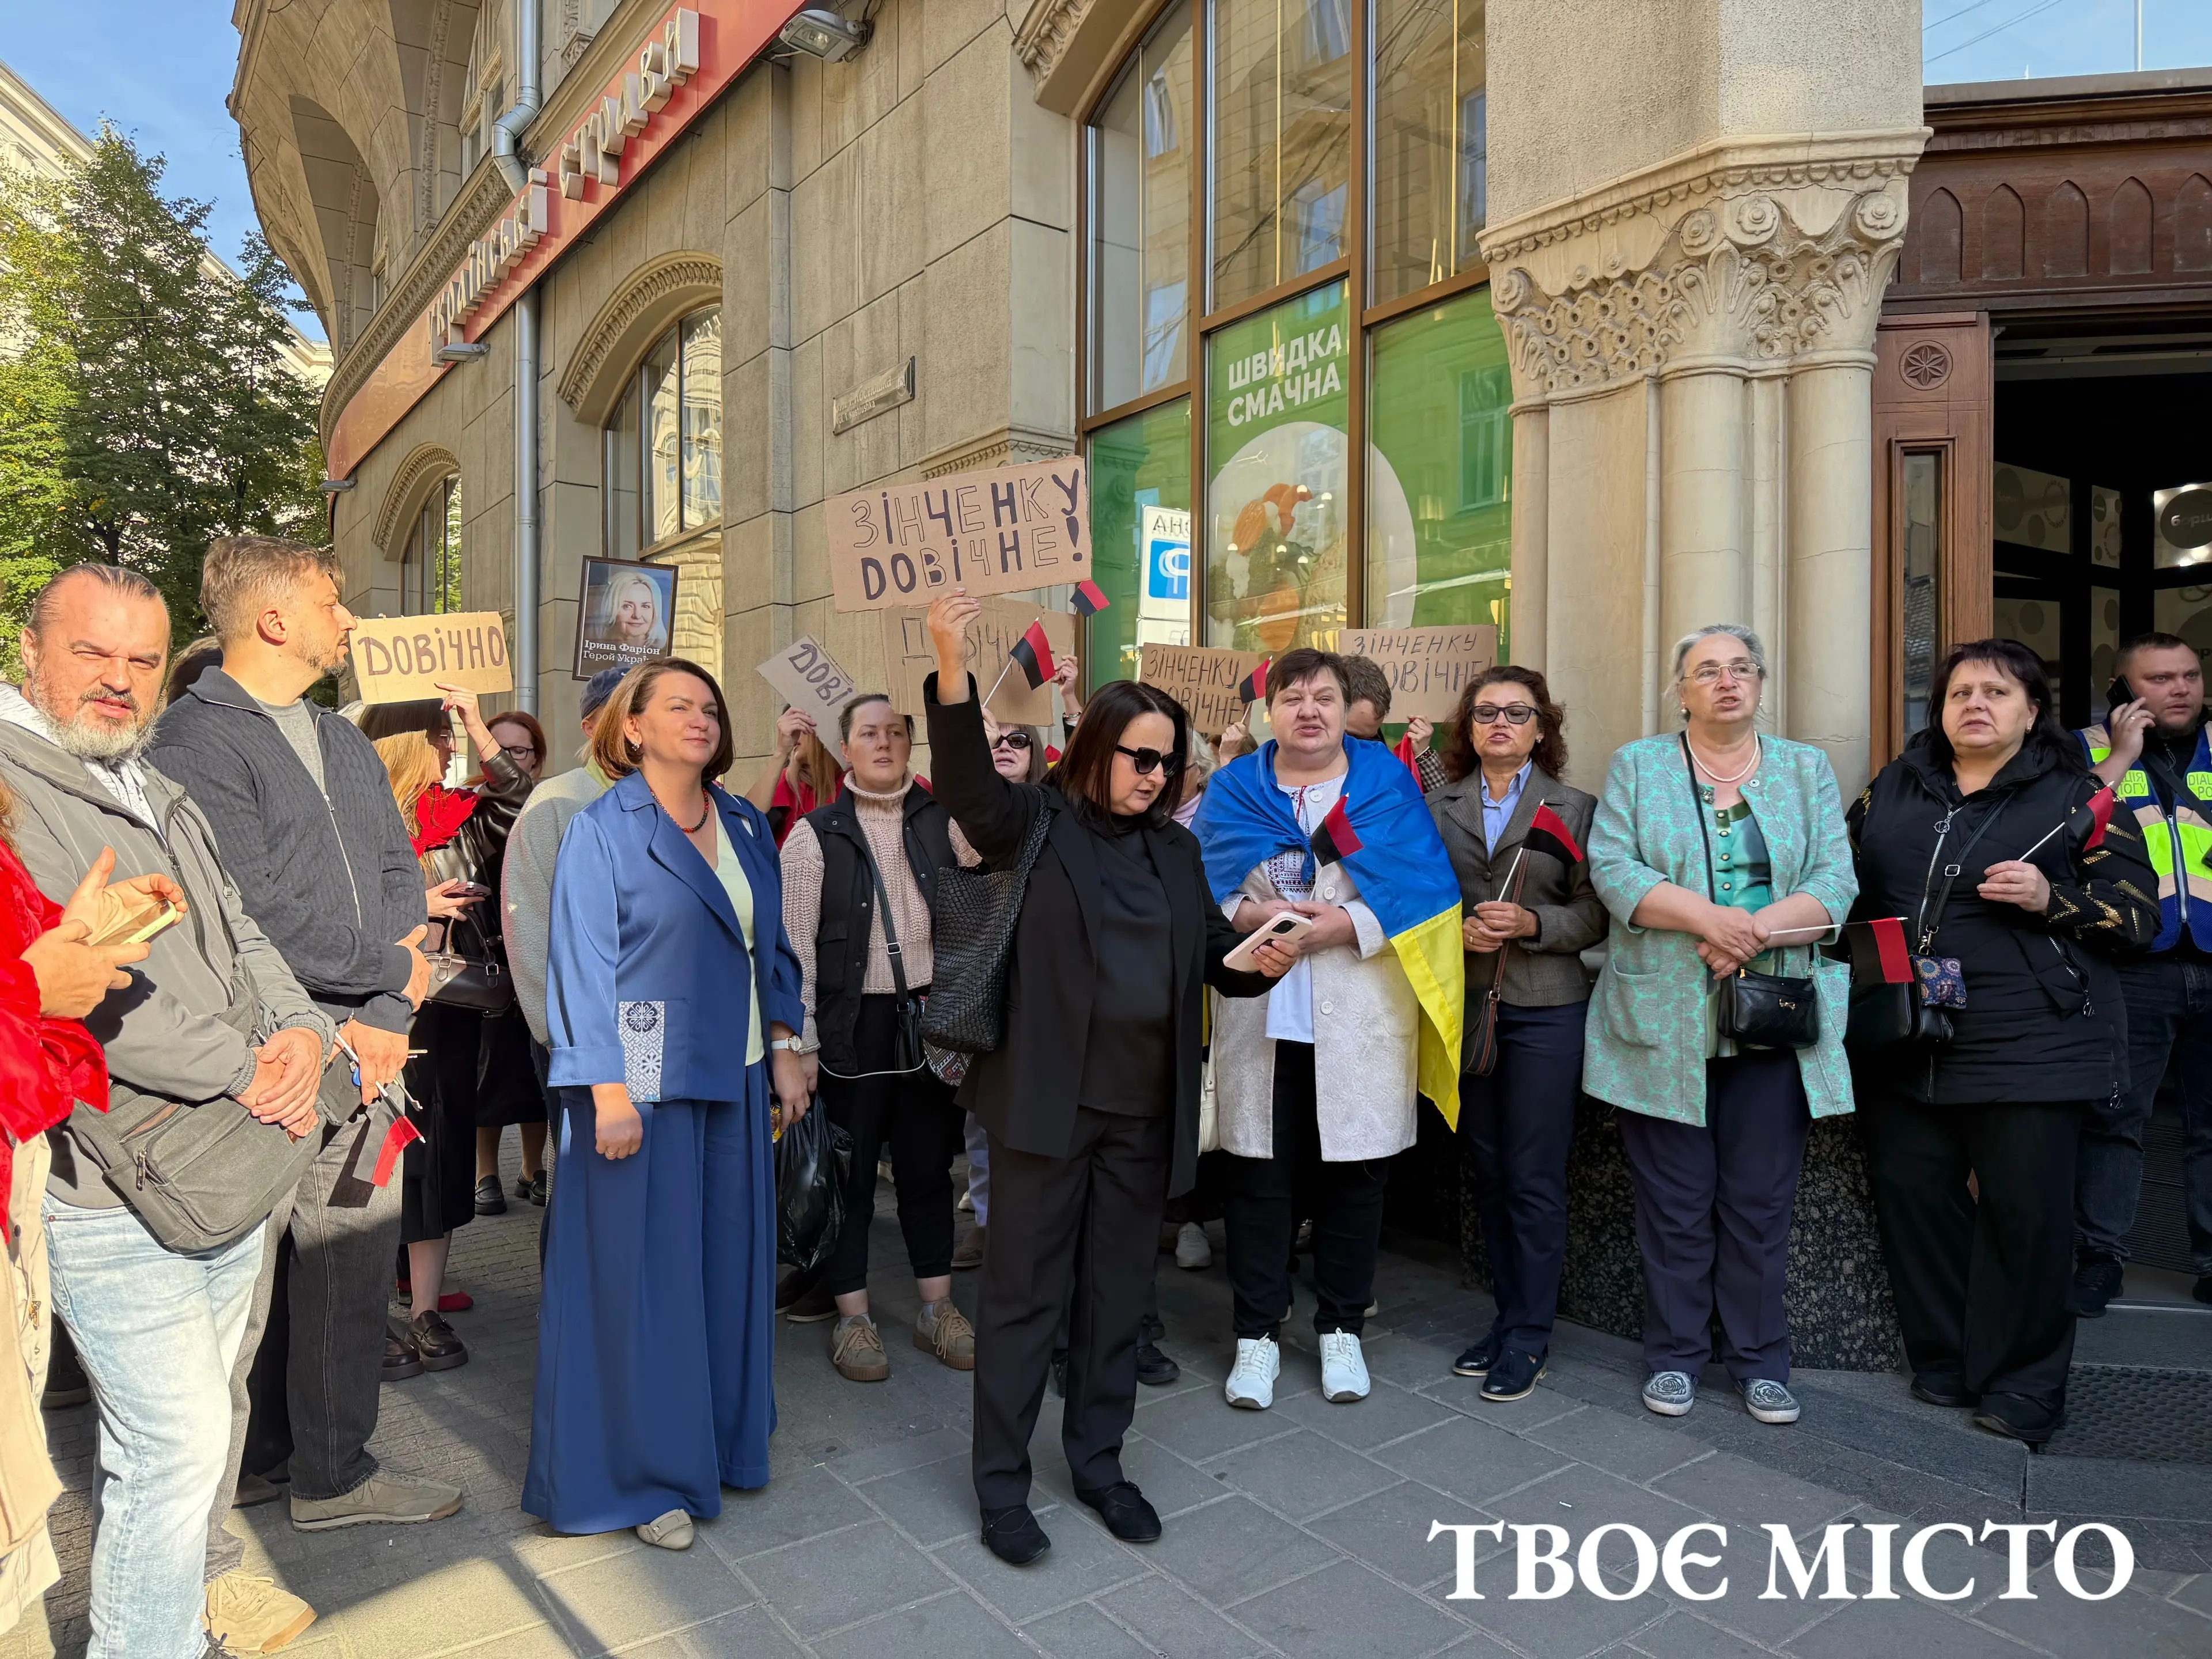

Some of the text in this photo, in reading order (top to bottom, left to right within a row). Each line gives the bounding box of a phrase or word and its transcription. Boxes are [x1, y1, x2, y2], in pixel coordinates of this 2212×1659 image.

[1229, 324, 1342, 391] ШВИДКА
[1228, 362, 1341, 426] СМАЧНА
[583, 650, 649, 664] Герой Украї
[585, 640, 660, 655] Ірина Фаріон
